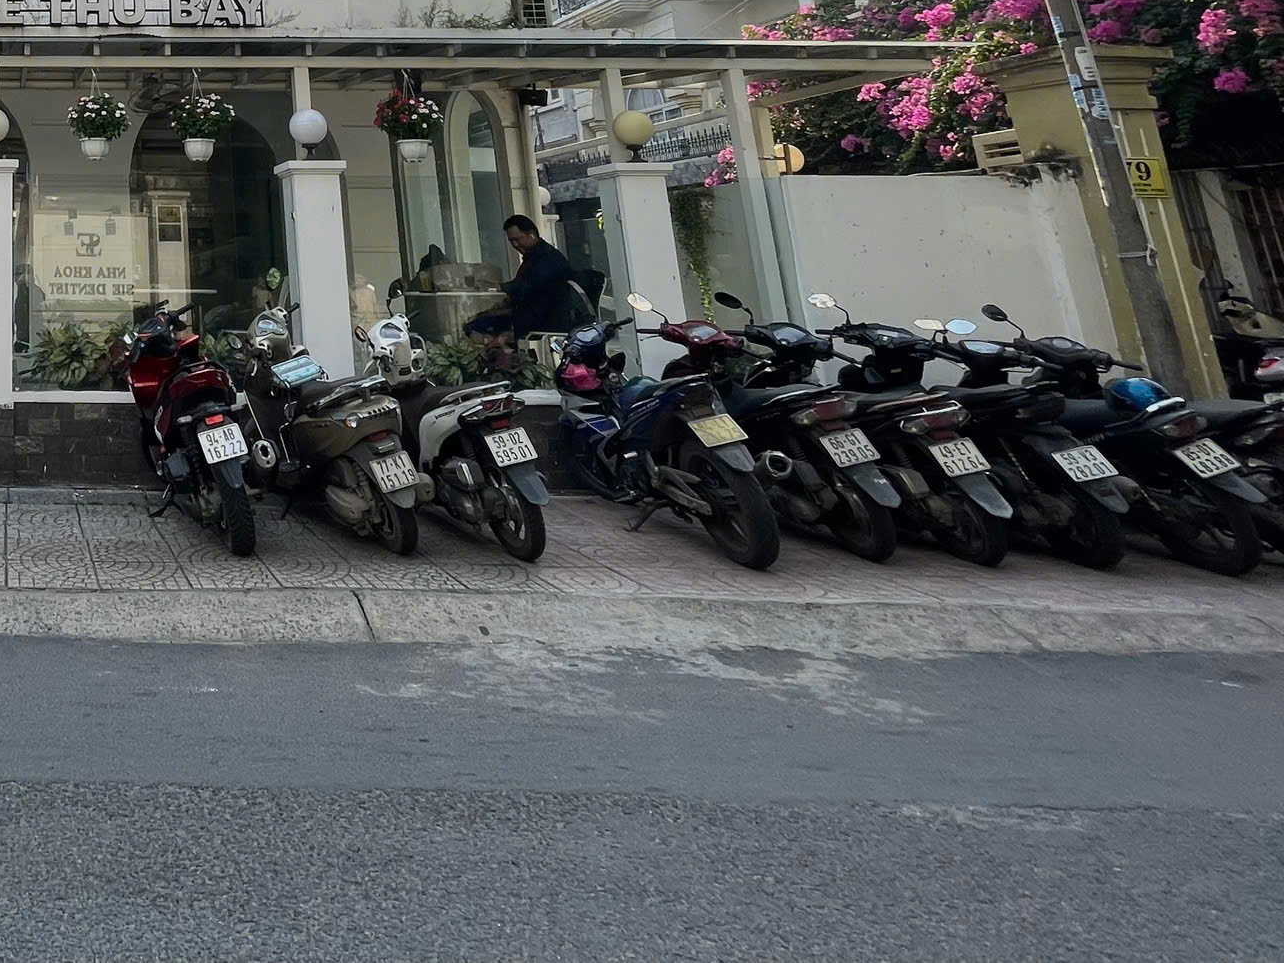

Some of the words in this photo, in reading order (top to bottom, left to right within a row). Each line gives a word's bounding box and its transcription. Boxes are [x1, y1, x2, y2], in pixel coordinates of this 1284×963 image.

[205, 427, 236, 447] 94-AB
[827, 432, 862, 450] 66-G1
[207, 439, 245, 461] 162.22
[495, 444, 534, 464] 595.01
[833, 444, 876, 465] 239.05
[938, 441, 972, 458] 49-E1
[375, 454, 407, 475] 77-K1
[380, 468, 417, 490] 151.19
